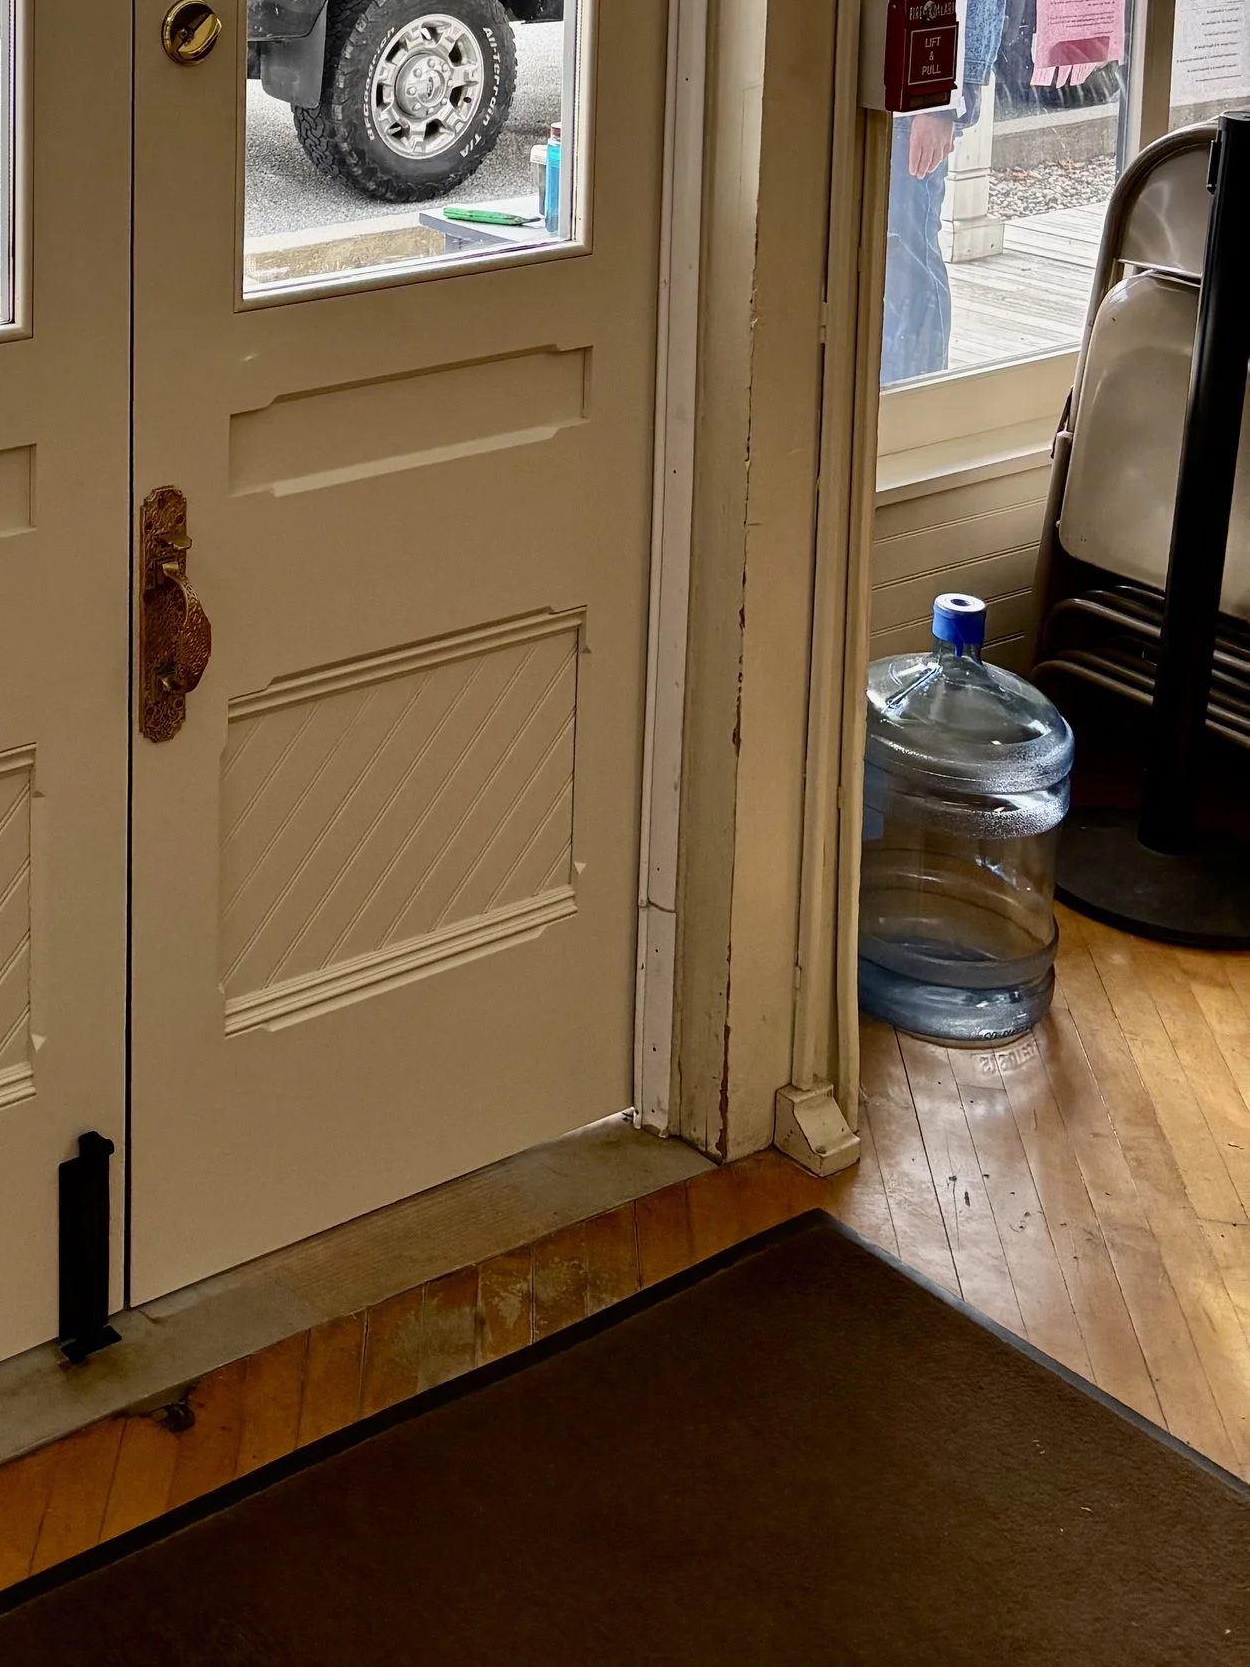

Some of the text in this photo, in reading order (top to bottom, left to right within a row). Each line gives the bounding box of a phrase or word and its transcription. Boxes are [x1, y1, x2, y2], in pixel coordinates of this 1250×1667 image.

[925, 37, 941, 48] LIFT
[929, 51, 934, 61] &
[922, 64, 941, 76] PULL
